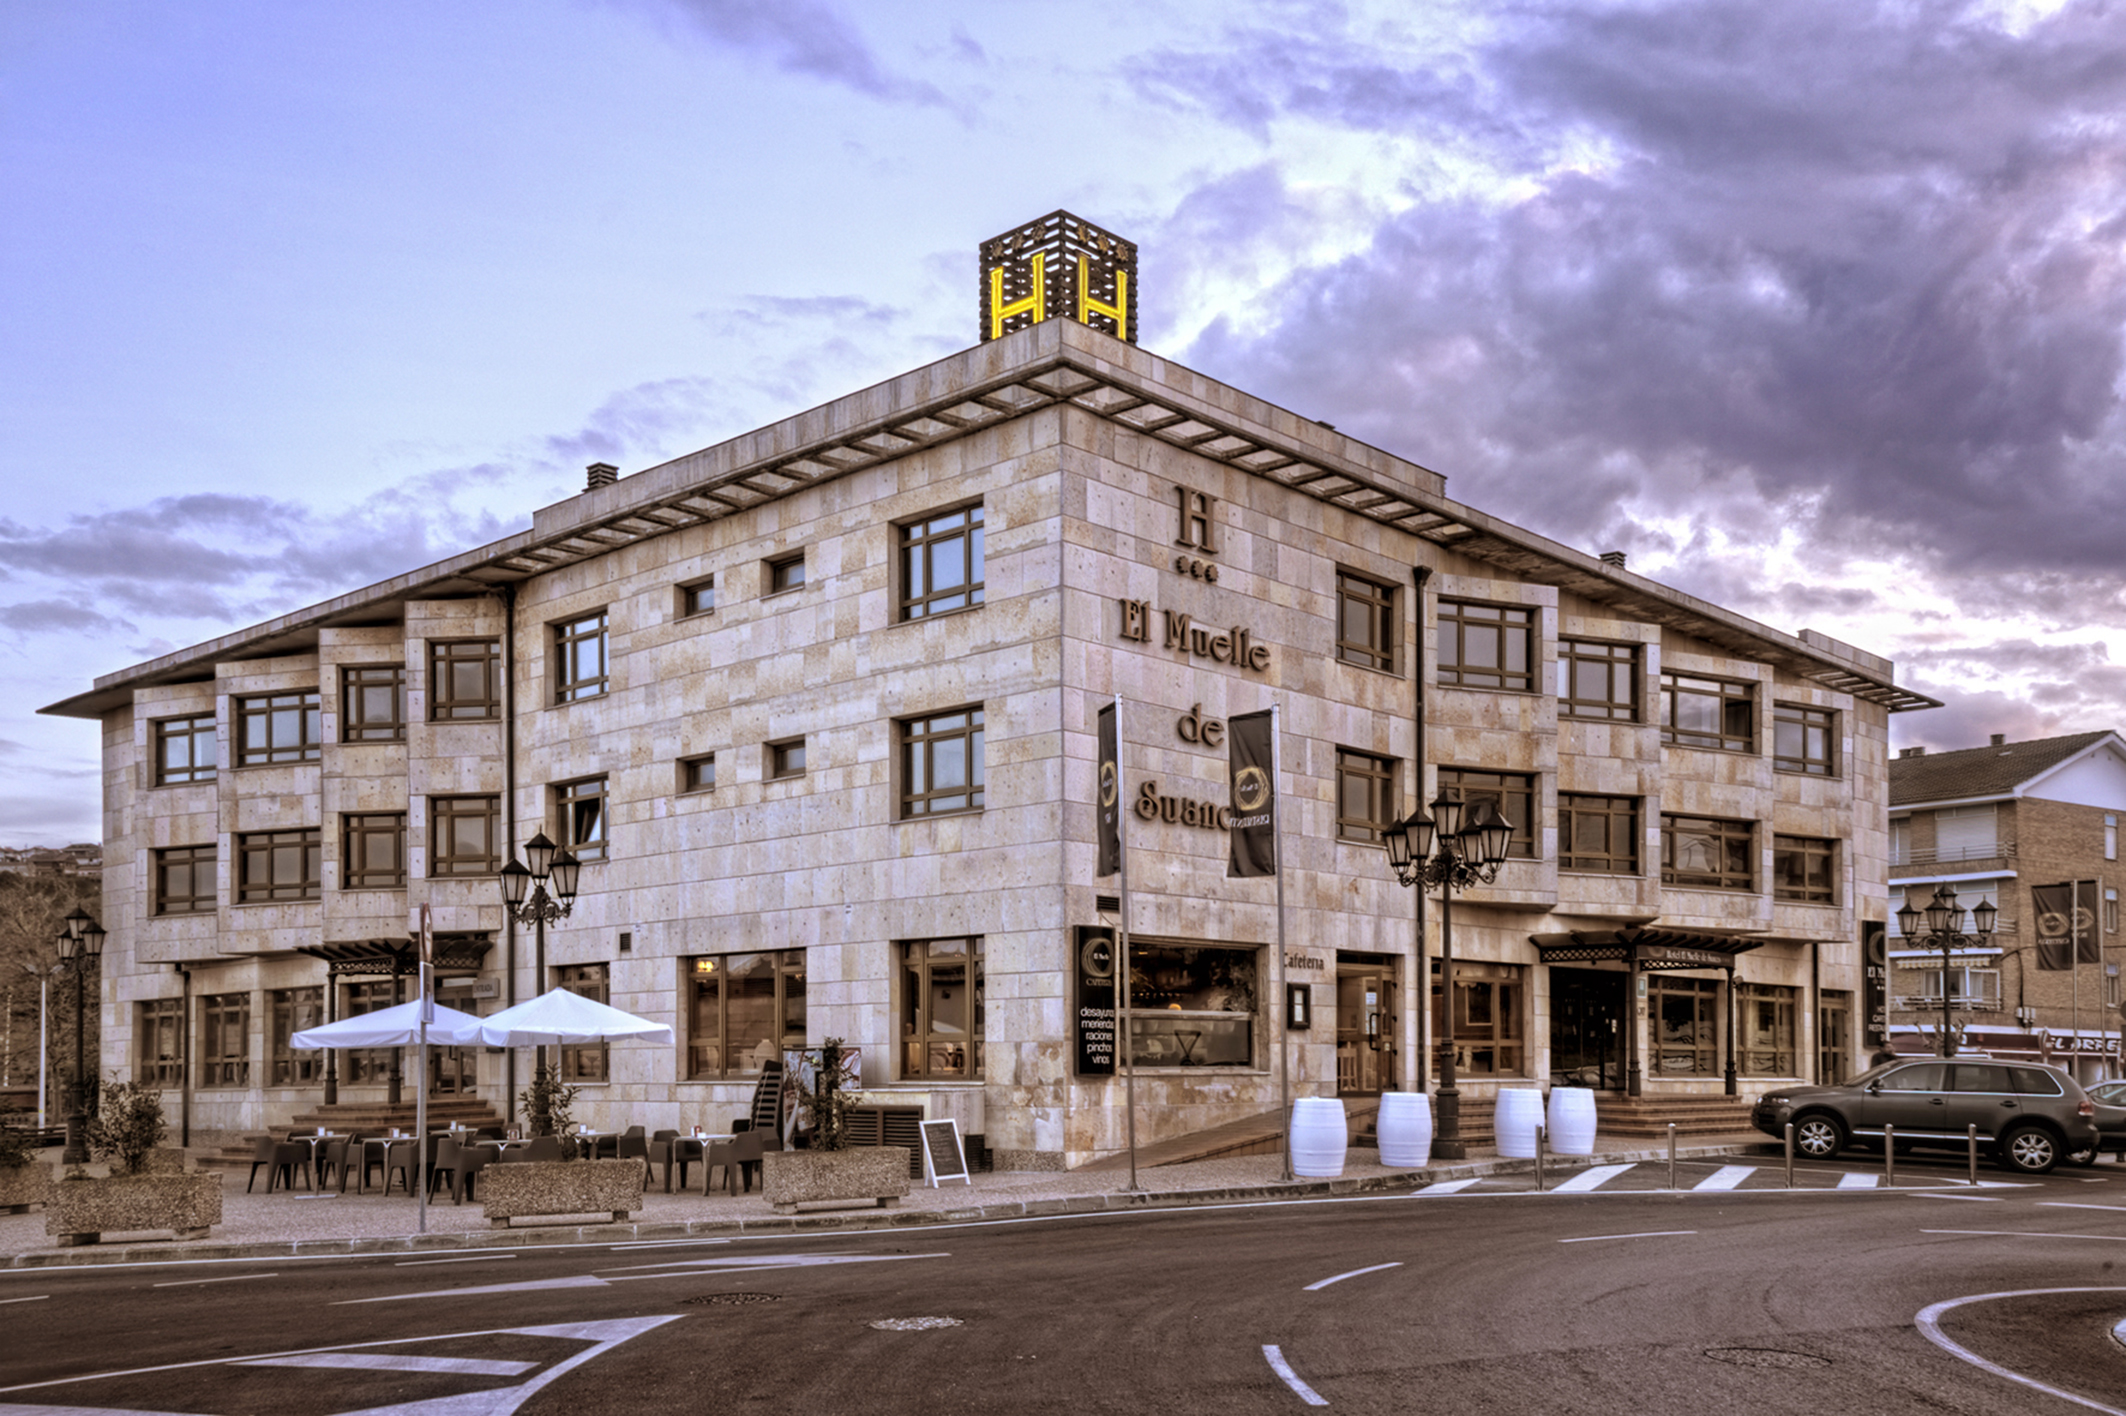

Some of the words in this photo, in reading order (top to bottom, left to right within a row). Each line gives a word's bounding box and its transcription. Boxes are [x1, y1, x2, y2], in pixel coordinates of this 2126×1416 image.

[1174, 484, 1219, 555] H
[1120, 598, 1152, 643] El
[1164, 609, 1271, 672] Muelle
[1177, 702, 1225, 748] de
[1134, 780, 1231, 831] Suanc
